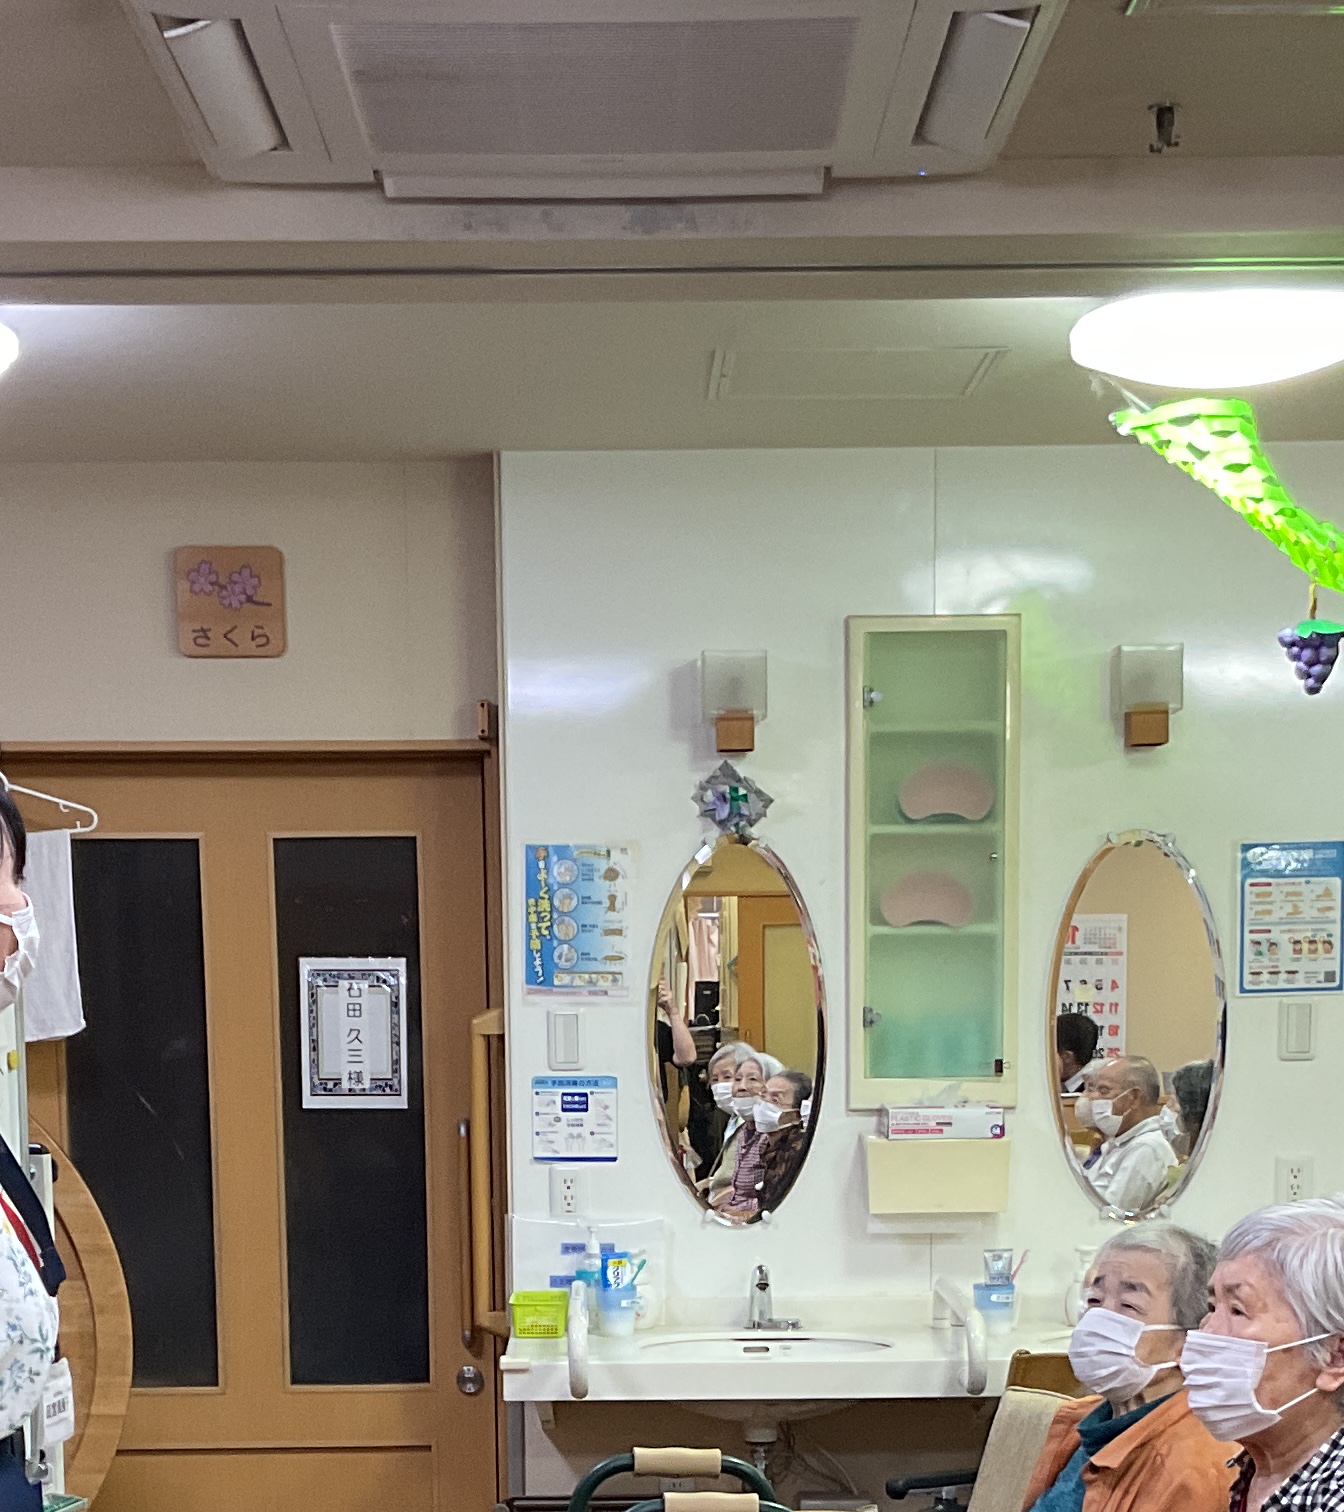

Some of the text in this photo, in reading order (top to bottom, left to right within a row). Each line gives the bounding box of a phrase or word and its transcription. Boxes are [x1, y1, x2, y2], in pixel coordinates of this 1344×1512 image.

[191, 625, 271, 649] さくら
[345, 981, 366, 1088] 石田久三様
